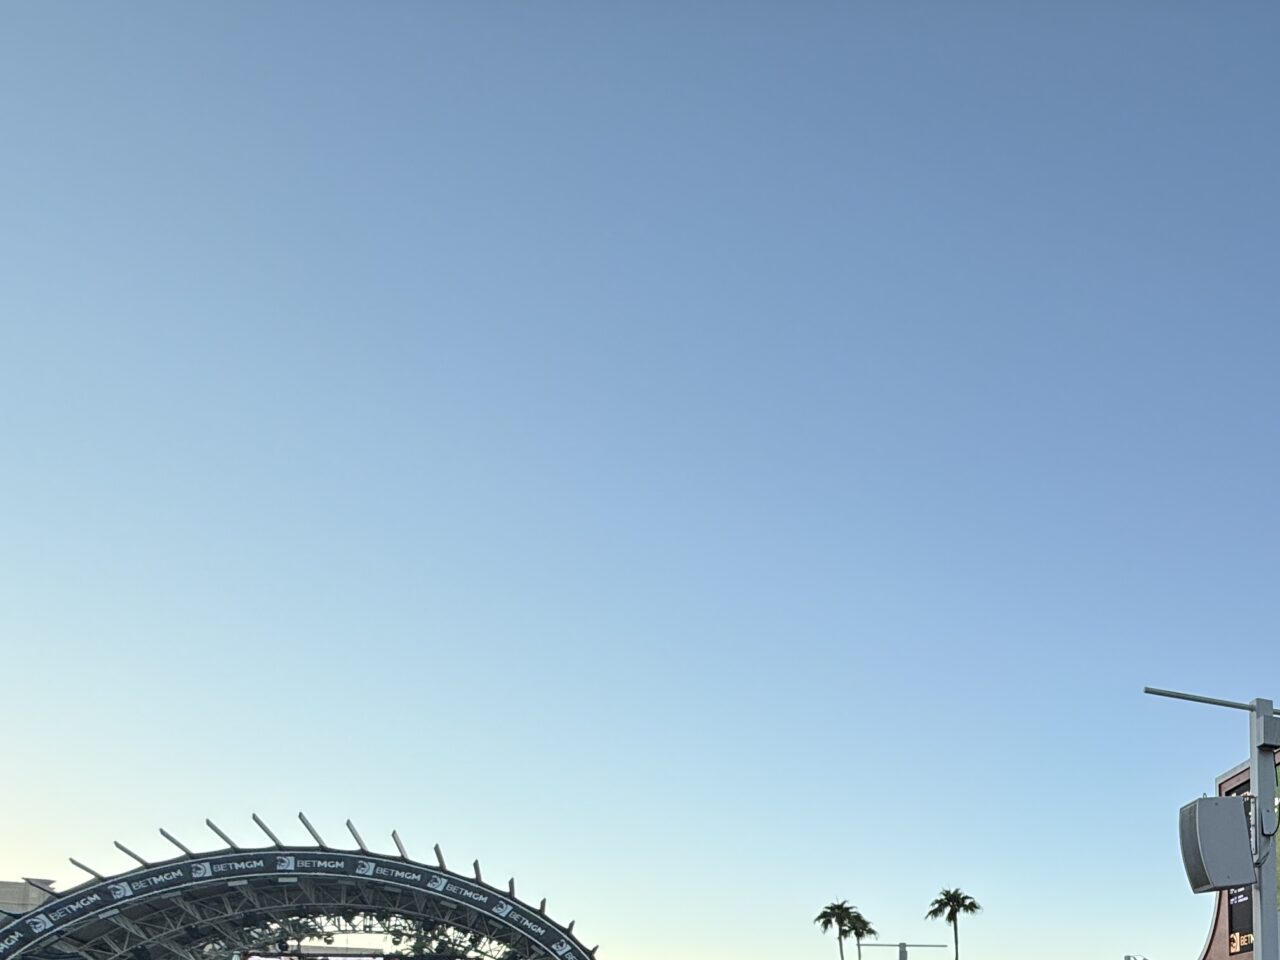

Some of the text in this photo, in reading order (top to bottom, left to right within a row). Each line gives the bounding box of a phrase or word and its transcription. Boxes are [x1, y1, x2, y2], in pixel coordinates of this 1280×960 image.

[212, 859, 264, 873] BETMGM
[296, 860, 345, 869] BETMGM
[375, 865, 422, 882] BETMGM
[131, 868, 184, 892] BETMGM
[445, 882, 488, 905] BETMGM
[50, 893, 101, 922] BETMGM
[508, 909, 546, 937] BETMGM
